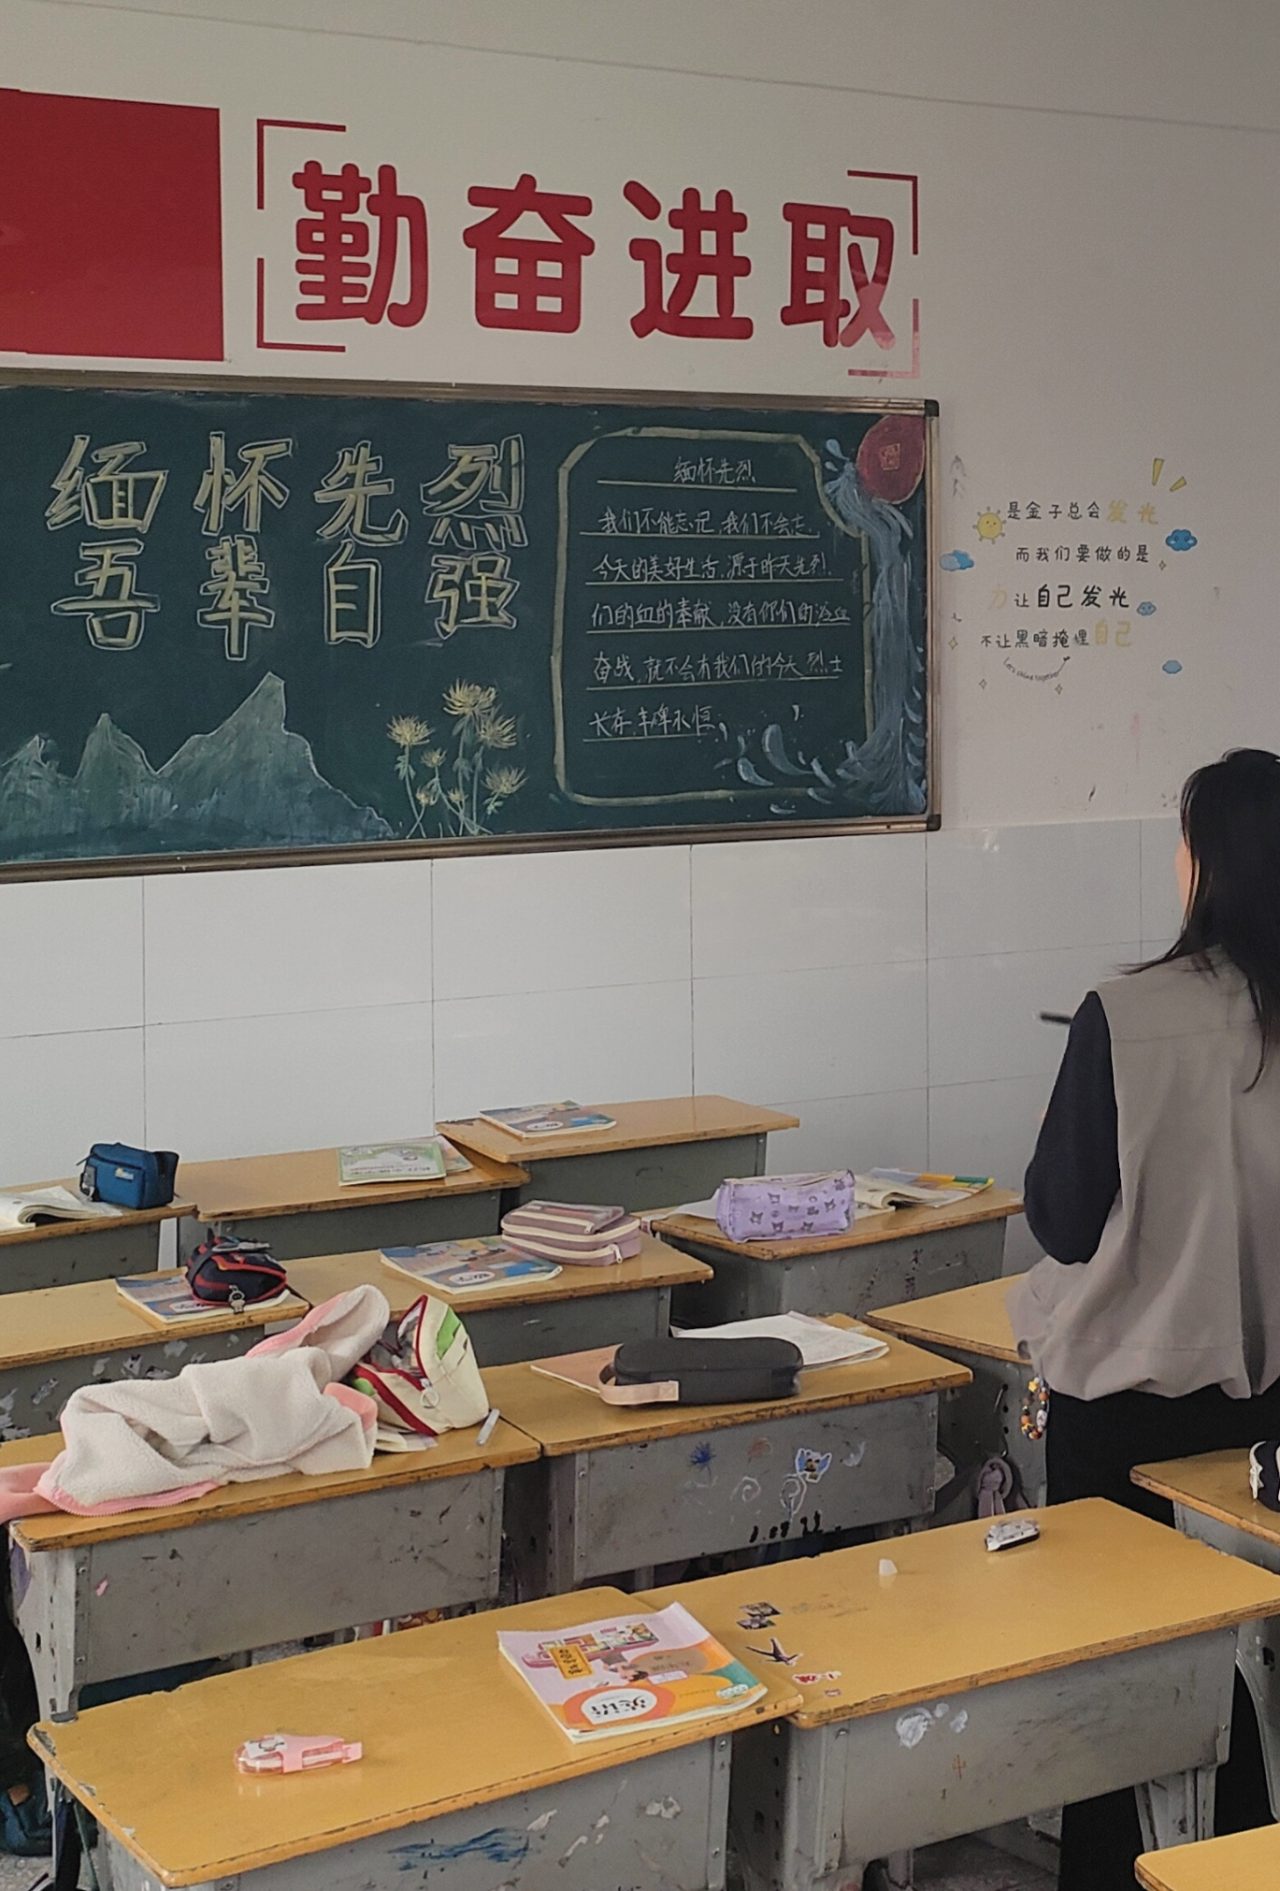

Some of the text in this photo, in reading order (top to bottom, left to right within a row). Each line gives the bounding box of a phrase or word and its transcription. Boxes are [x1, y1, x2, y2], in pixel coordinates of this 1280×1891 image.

[291, 159, 896, 350] 勤奋进取
[46, 431, 529, 550] 缅怀先烈
[672, 456, 757, 484] 缅怀先烈
[1006, 500, 1159, 525] 是金子总会发光
[1015, 544, 1150, 563] 而我们要做的是
[50, 535, 521, 661] 吾辈自强
